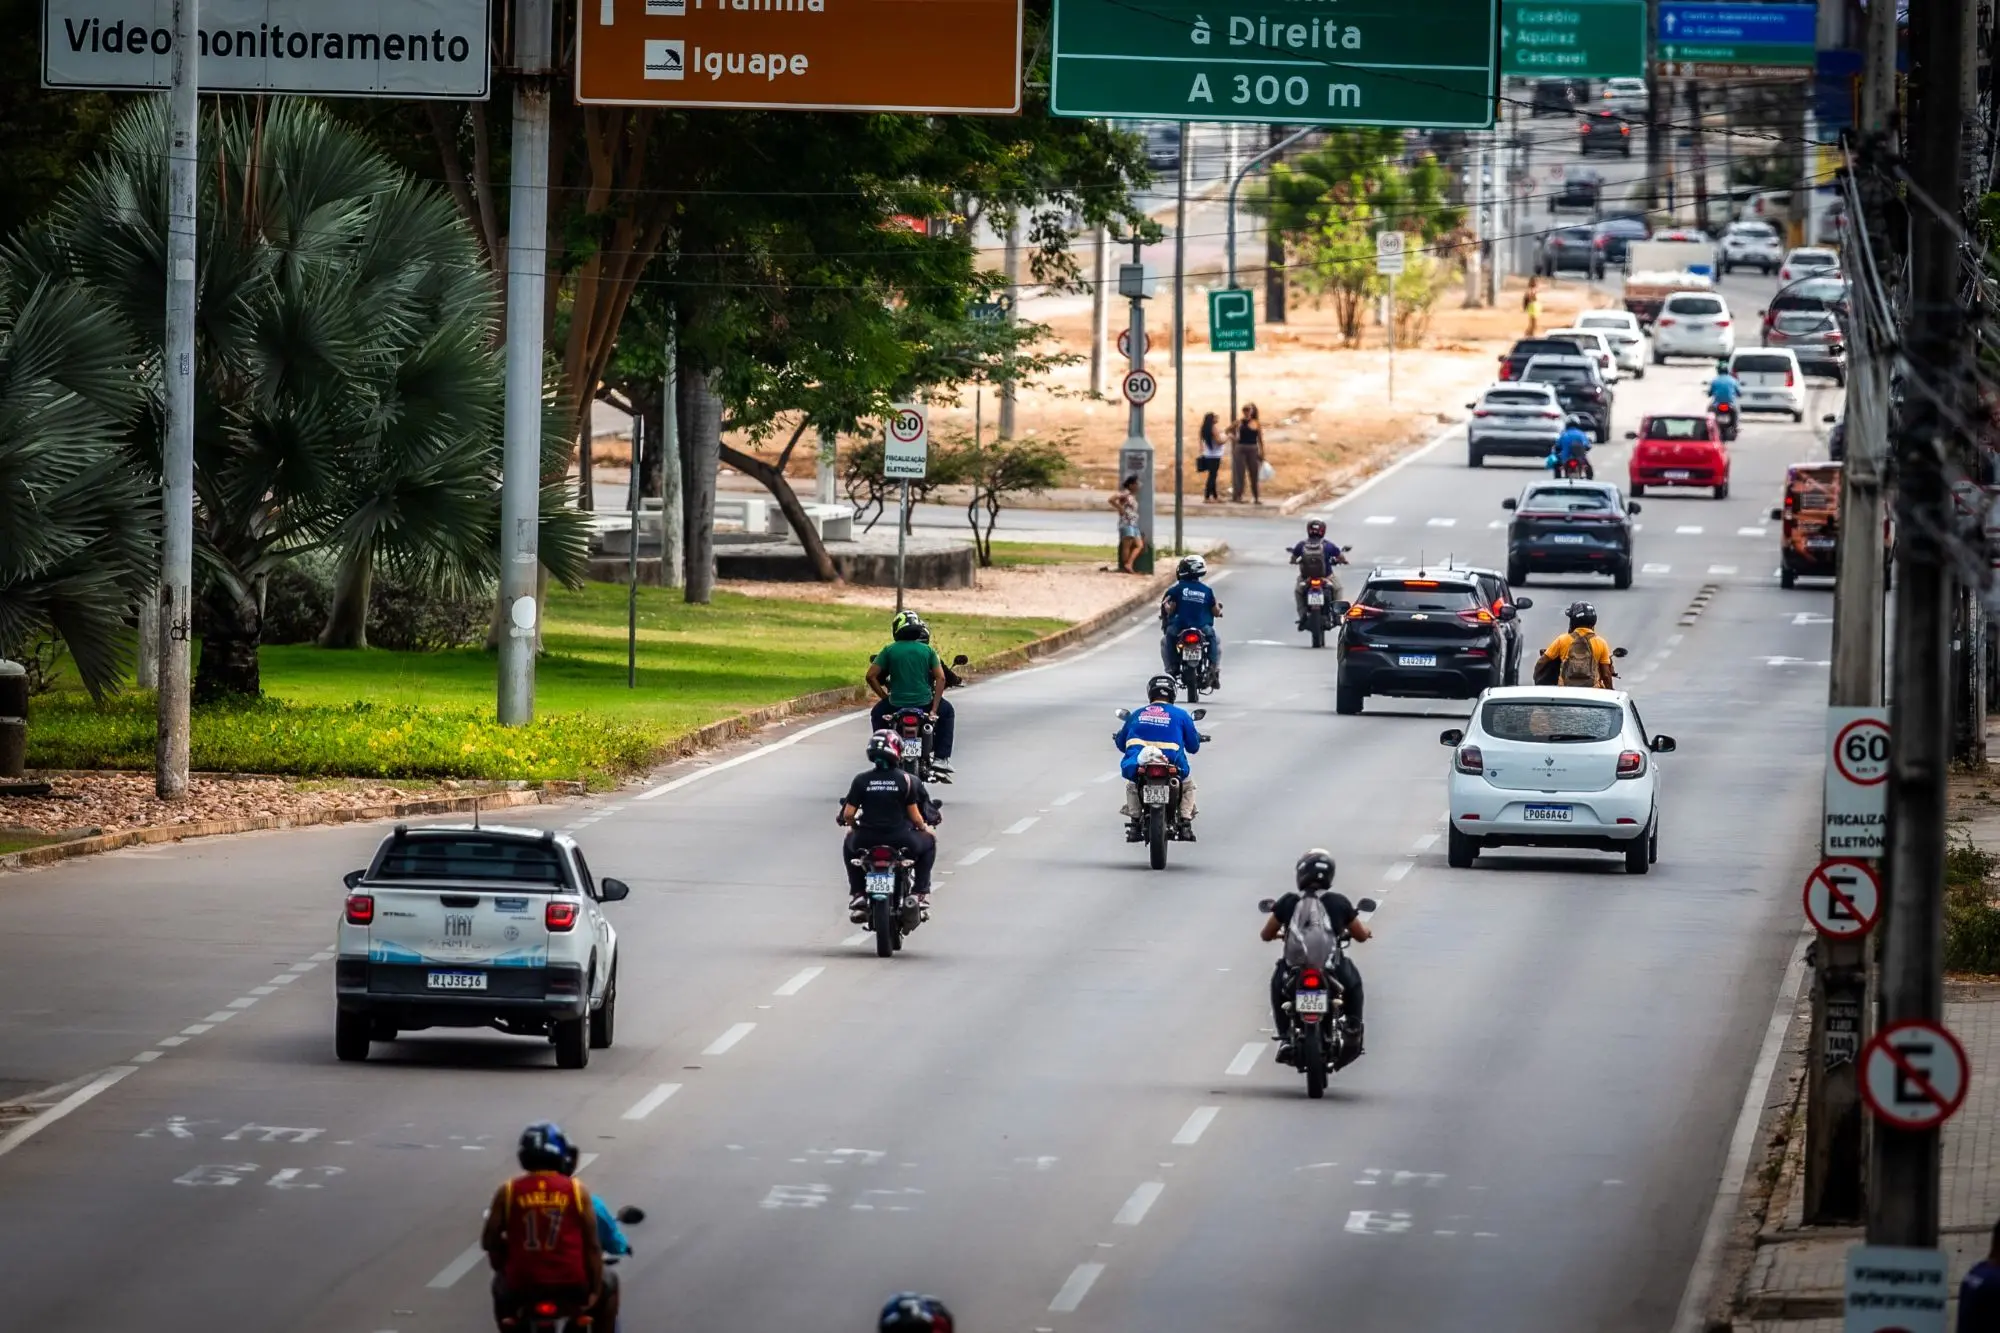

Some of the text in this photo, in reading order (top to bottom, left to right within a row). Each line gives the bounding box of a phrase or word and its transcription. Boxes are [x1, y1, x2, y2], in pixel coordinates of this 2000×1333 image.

[1516, 8, 1580, 24] Eusébio
[1190, 14, 1361, 49] à Direita
[694, 46, 809, 82] Iguape
[1516, 49, 1588, 65] Cascavel
[1187, 73, 1361, 108] A 300 m
[1129, 377, 1152, 393] 60
[897, 417, 918, 431] 60
[886, 454, 926, 463] FISCALIZAÇÃO
[886, 465, 923, 474] ELETRÔNICA
[1846, 734, 1890, 762] 60
[523, 1208, 562, 1251] 17
